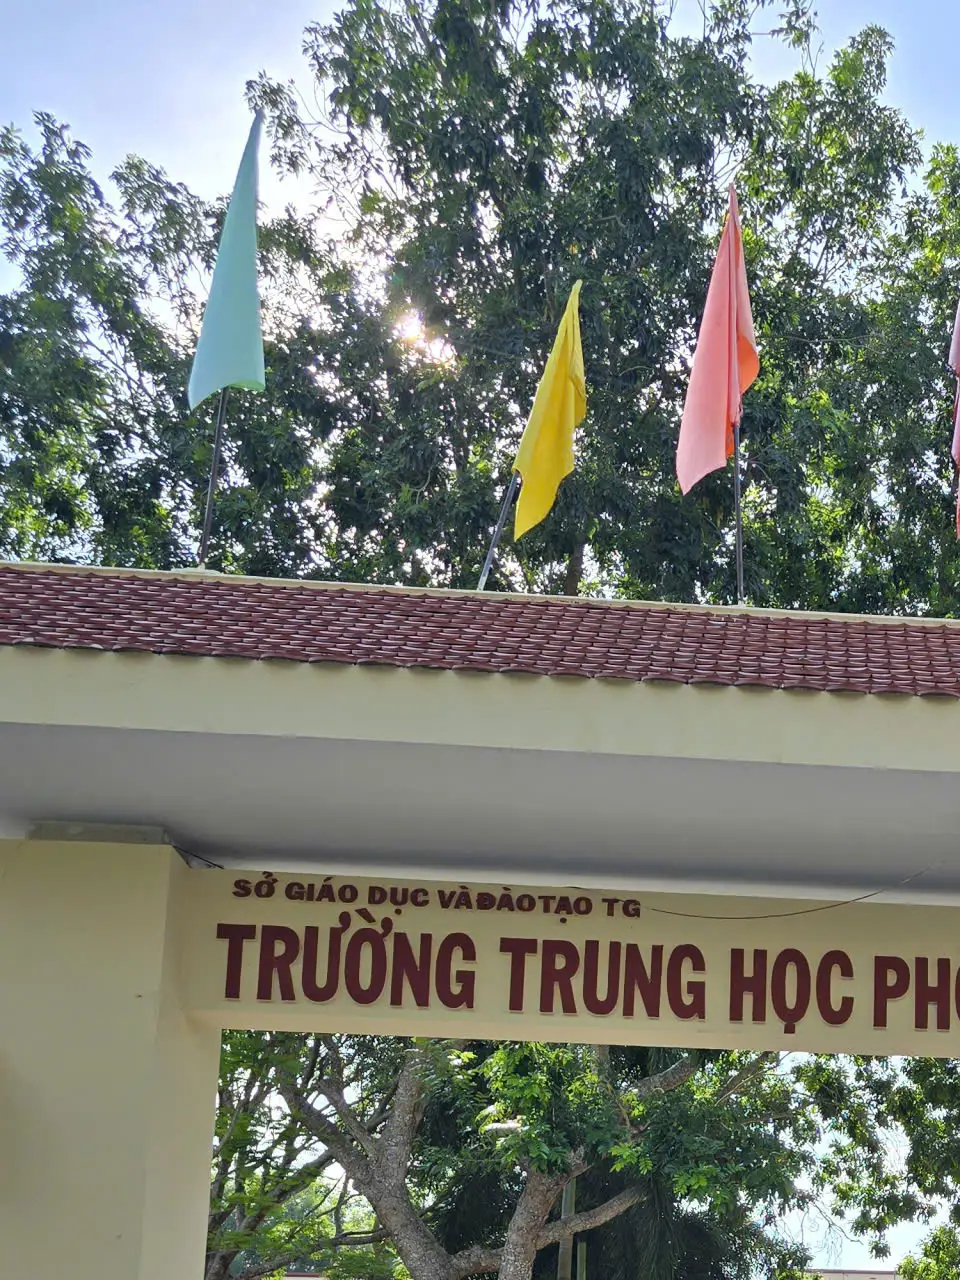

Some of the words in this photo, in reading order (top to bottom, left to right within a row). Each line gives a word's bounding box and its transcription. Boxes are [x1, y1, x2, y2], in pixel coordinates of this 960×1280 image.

[232, 871, 279, 898] SỞ
[285, 876, 359, 904] GIÁO
[367, 885, 430, 916] DỤC
[538, 895, 593, 924] TẠO
[601, 897, 641, 918] TG
[216, 908, 477, 1010] TRƯỜNG
[500, 937, 707, 1021] TRUNG
[729, 947, 855, 1034] HỌC
